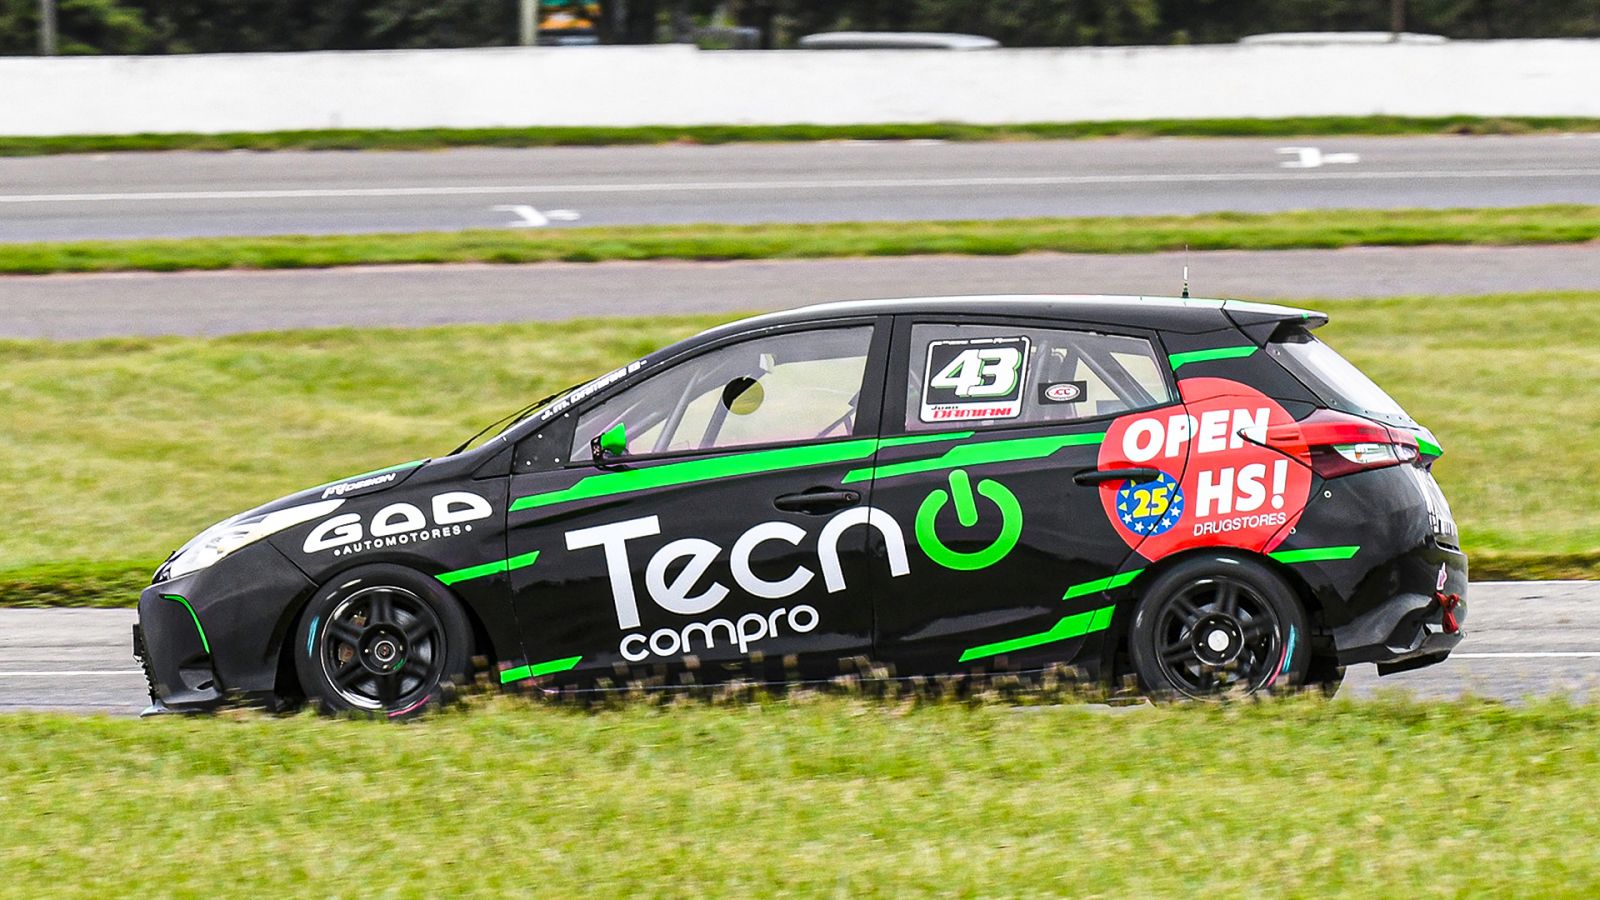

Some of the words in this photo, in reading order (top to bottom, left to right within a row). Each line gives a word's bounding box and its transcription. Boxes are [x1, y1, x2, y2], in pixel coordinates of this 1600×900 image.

[931, 347, 1022, 398] 43
[933, 407, 1012, 419] DAMIANI
[1122, 407, 1271, 463] OPEN
[1132, 487, 1169, 519] 25
[1195, 459, 1289, 518] HS!
[342, 524, 462, 556] AUTOMOTORES
[1193, 512, 1287, 537] DRUGSTORES
[619, 603, 820, 662] compro
